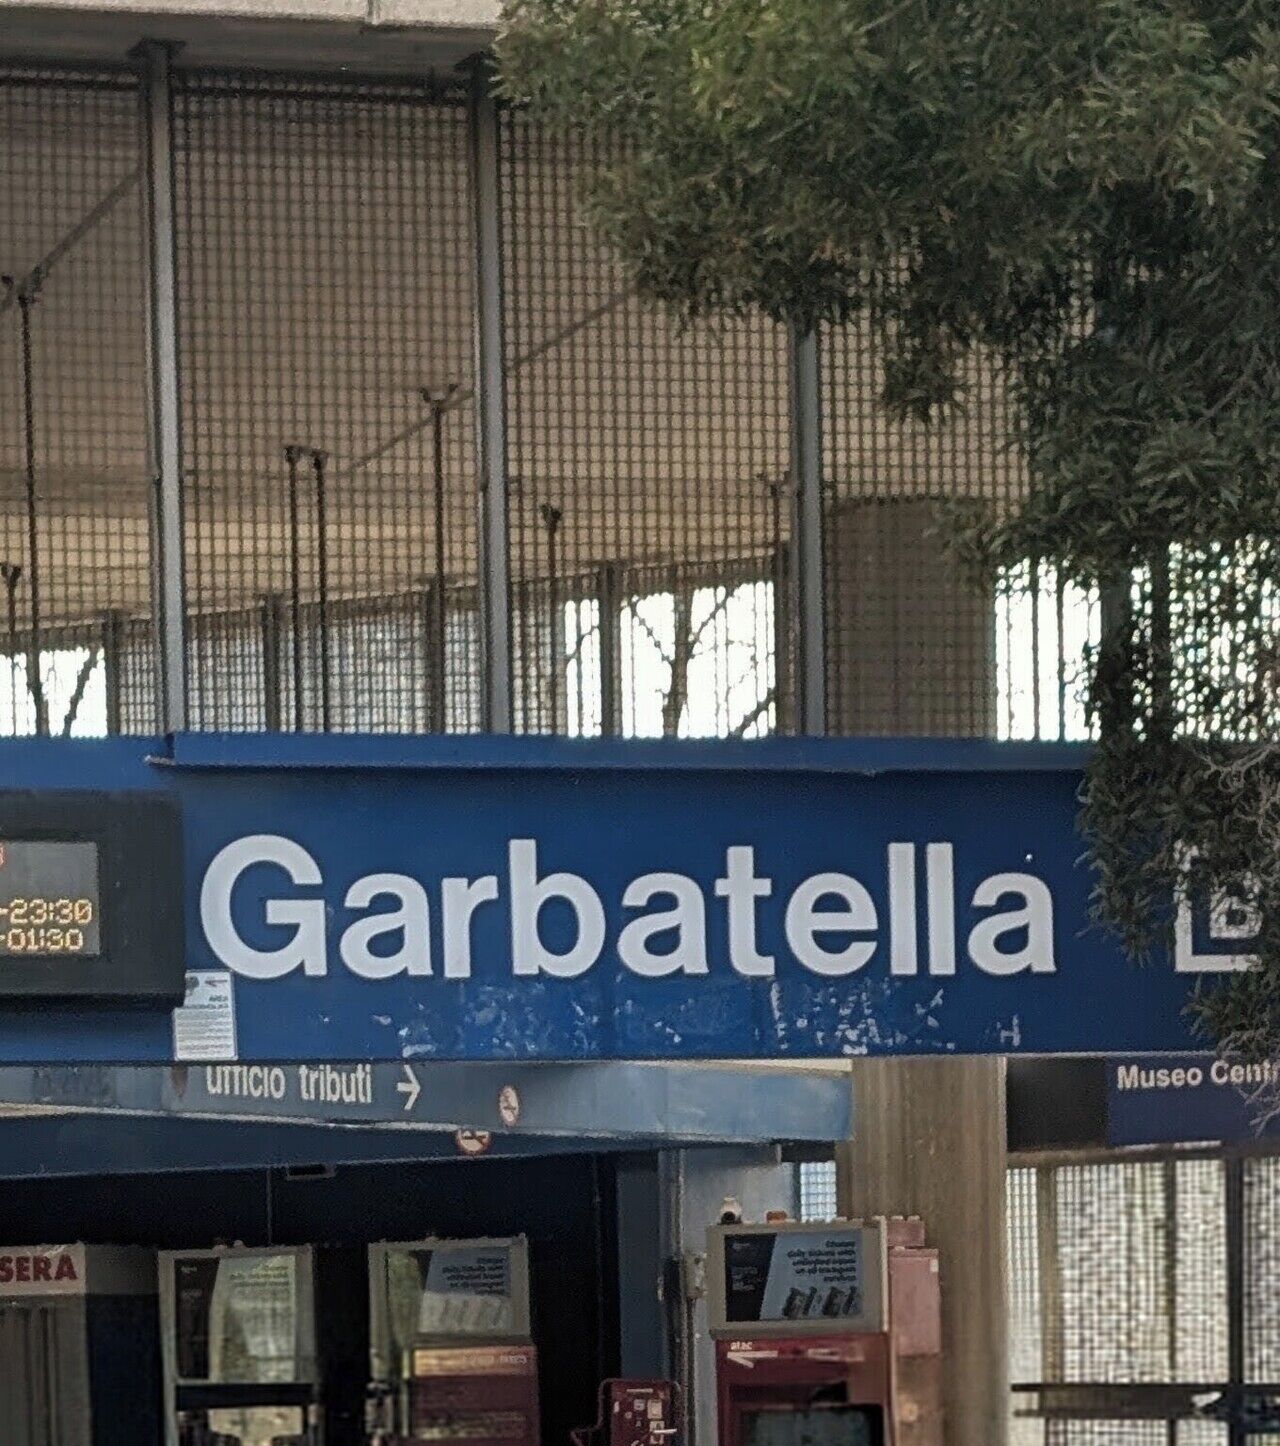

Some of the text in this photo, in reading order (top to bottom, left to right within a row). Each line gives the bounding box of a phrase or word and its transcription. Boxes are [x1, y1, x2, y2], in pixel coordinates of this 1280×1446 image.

[199, 834, 1056, 979] Garbatella
[298, 1063, 372, 1104] tributi
[1117, 1064, 1202, 1090] Museo
